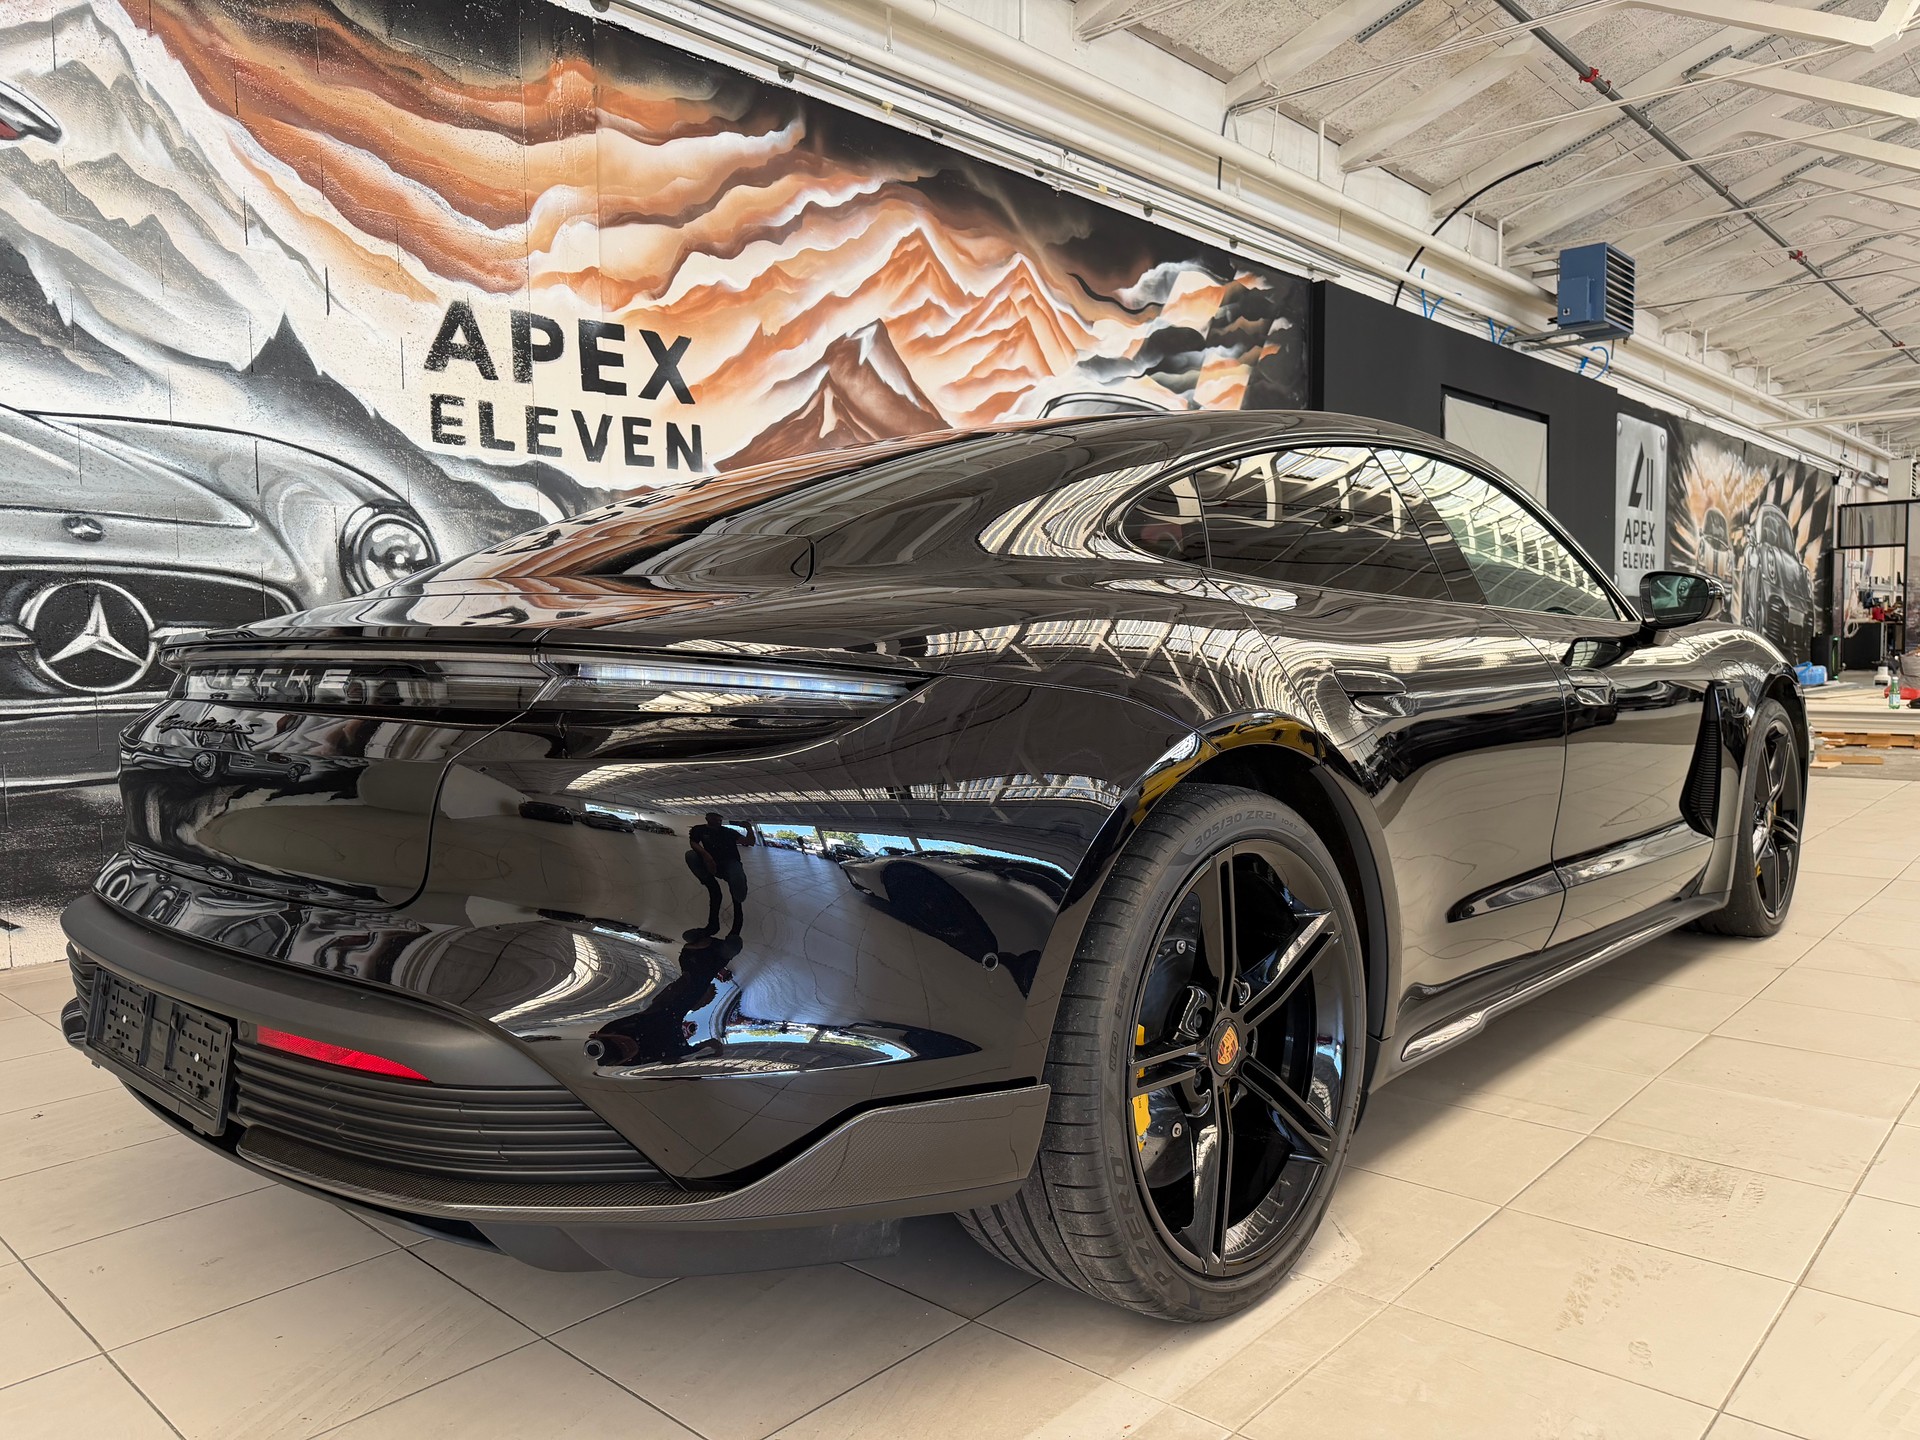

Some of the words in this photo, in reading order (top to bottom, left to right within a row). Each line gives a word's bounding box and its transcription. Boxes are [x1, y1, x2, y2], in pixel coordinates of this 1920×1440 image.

[424, 300, 696, 404] APEX
[429, 393, 704, 472] ELEVEN
[1623, 518, 1656, 547] APEX
[1622, 551, 1656, 570] ELEVEN
[1194, 812, 1243, 850] 305/30
[1245, 810, 1277, 821] ZR21
